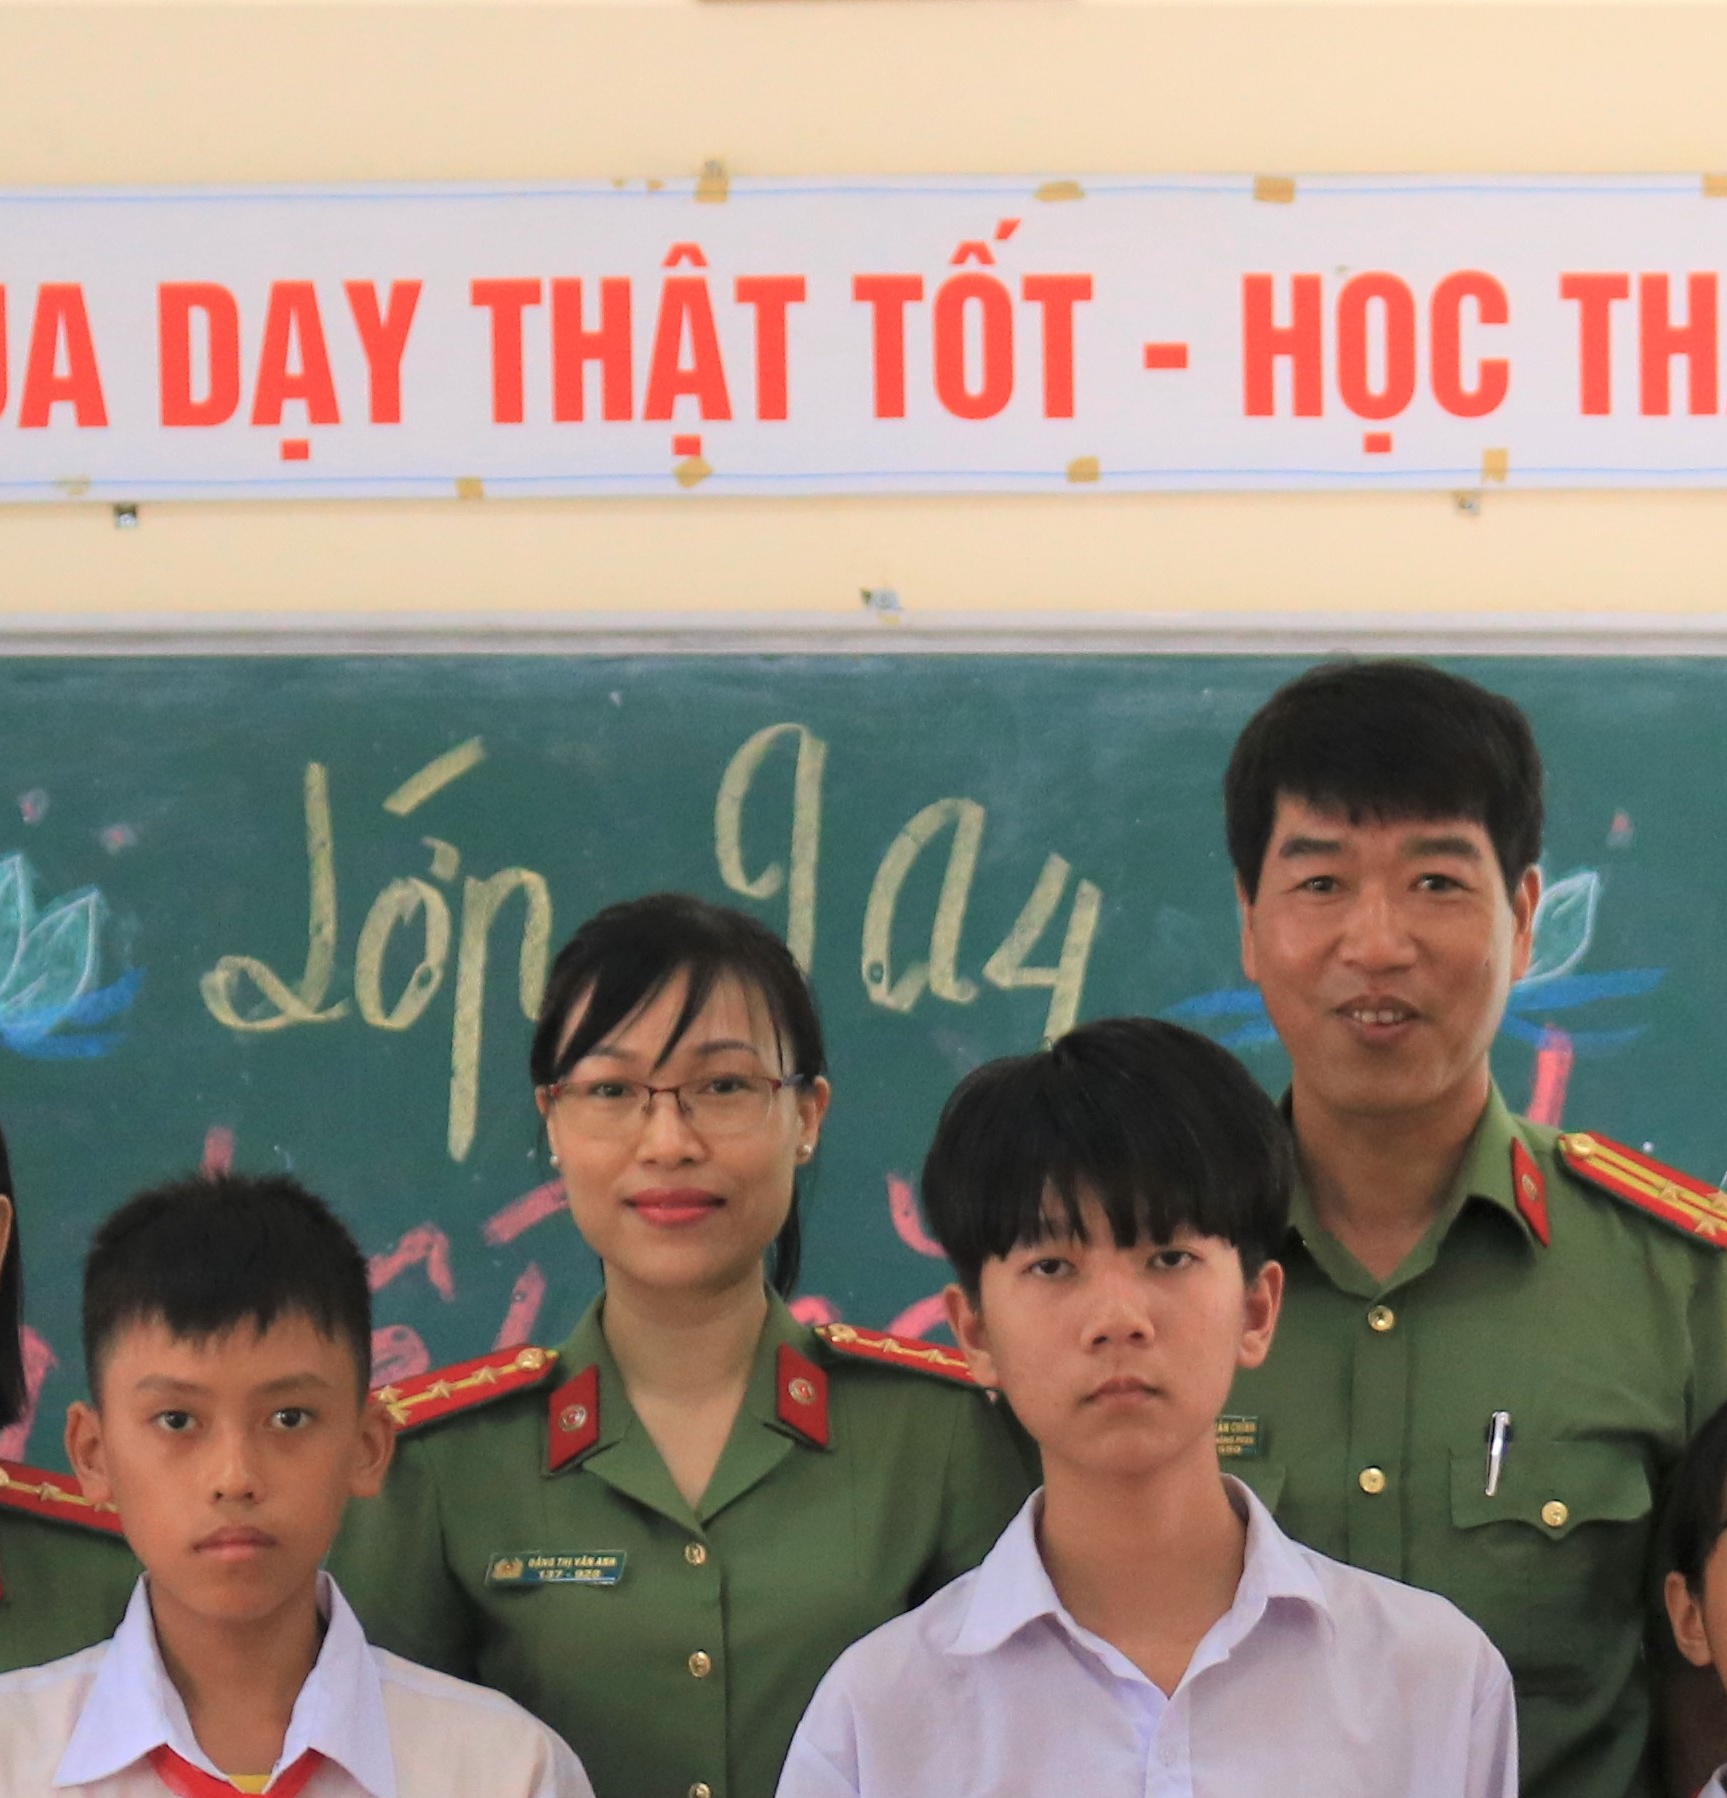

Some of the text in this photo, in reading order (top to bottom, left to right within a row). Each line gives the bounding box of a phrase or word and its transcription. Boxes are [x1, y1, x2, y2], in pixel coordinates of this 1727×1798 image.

[157, 279, 423, 461] DẠY
[470, 241, 806, 459] THẬT
[852, 218, 1094, 421] TỐT
[1143, 342, 1189, 371] -
[1241, 269, 1510, 454] HỌC
[200, 736, 557, 1162] Lớp
